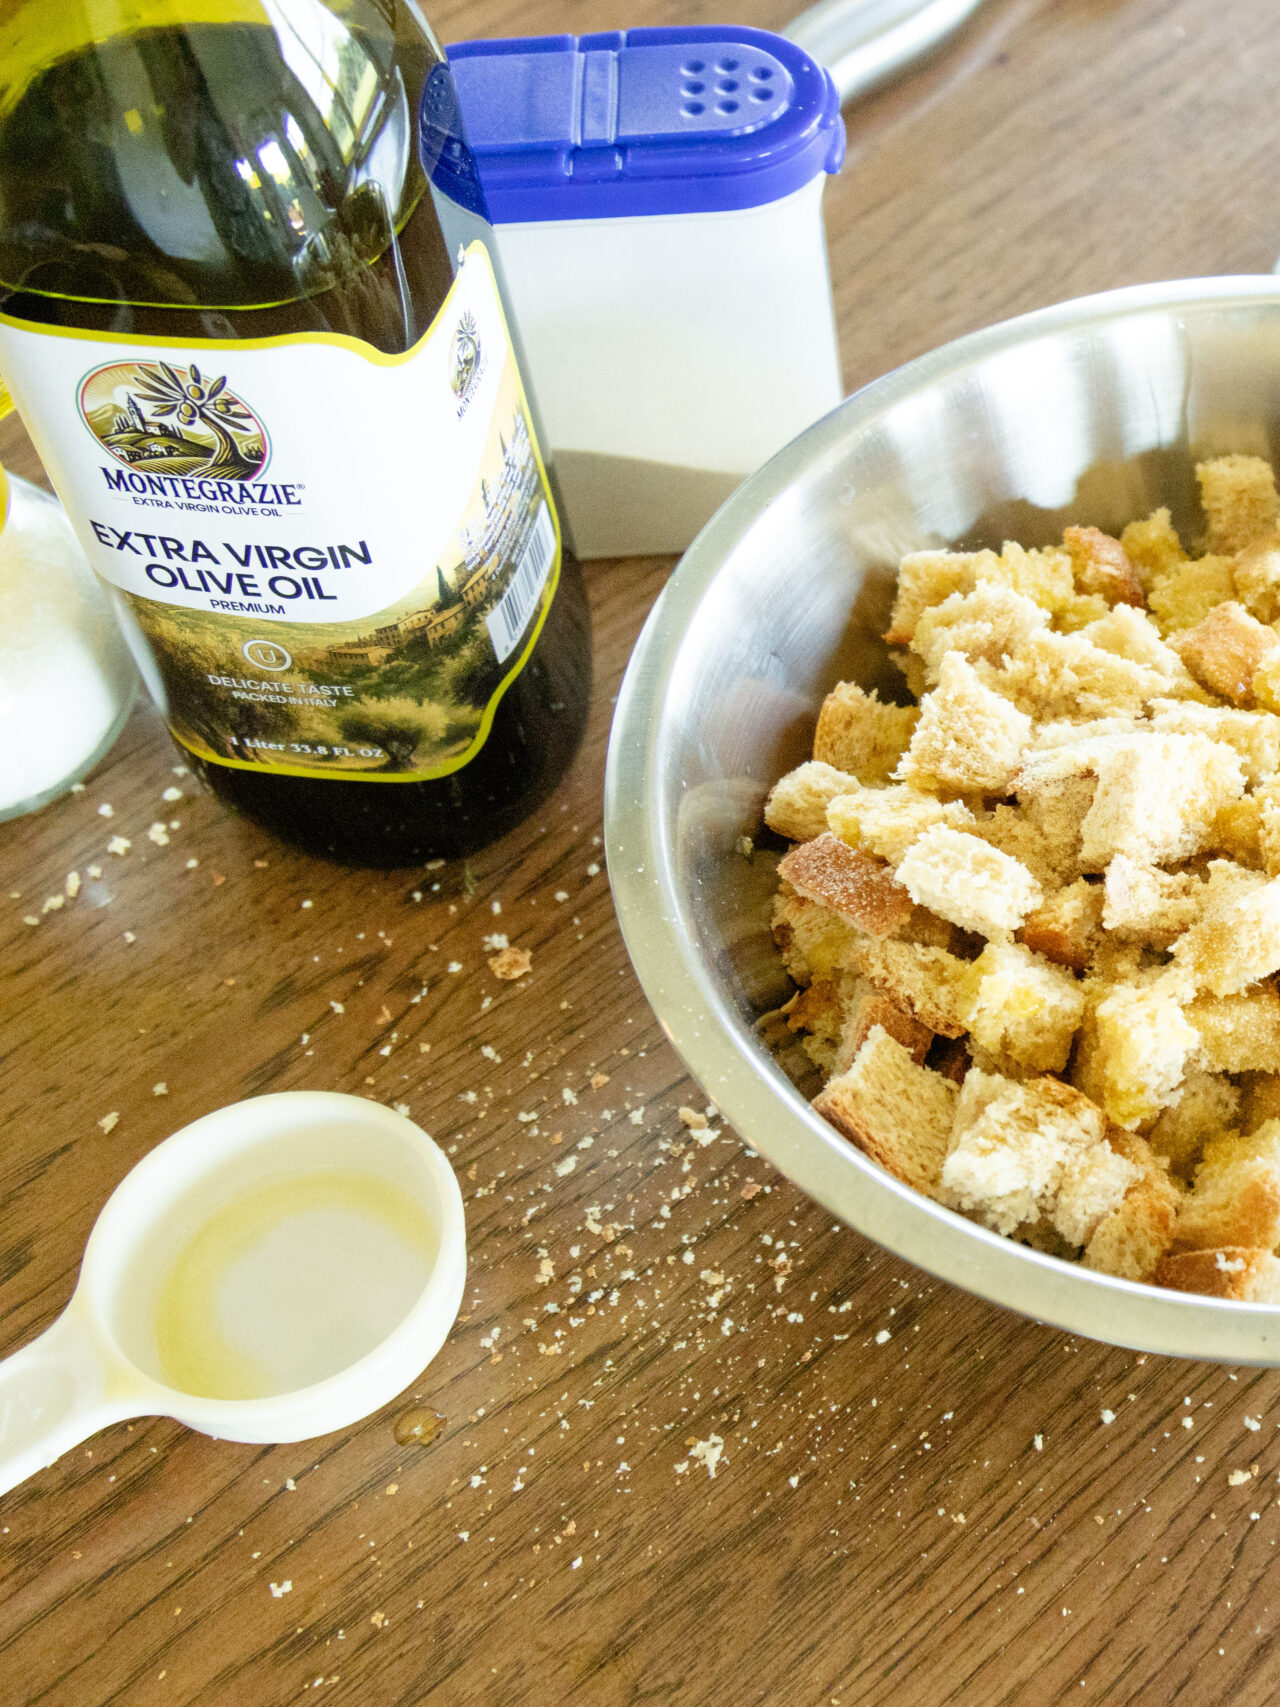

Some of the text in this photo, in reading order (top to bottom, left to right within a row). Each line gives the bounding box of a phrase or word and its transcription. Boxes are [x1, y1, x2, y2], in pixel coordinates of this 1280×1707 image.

[133, 496, 283, 517] EXTRA VIRGIN OLIVE OIL
[89, 519, 373, 571] EXTRA VIRGIN
[145, 563, 338, 600] OLIVE OIL
[210, 599, 286, 614] PREMIUM
[207, 674, 355, 697] DELICATE TASTE
[231, 690, 337, 708] PACKED IN ITALY
[230, 736, 385, 758] 1 Liter 33.8 FL OZ
